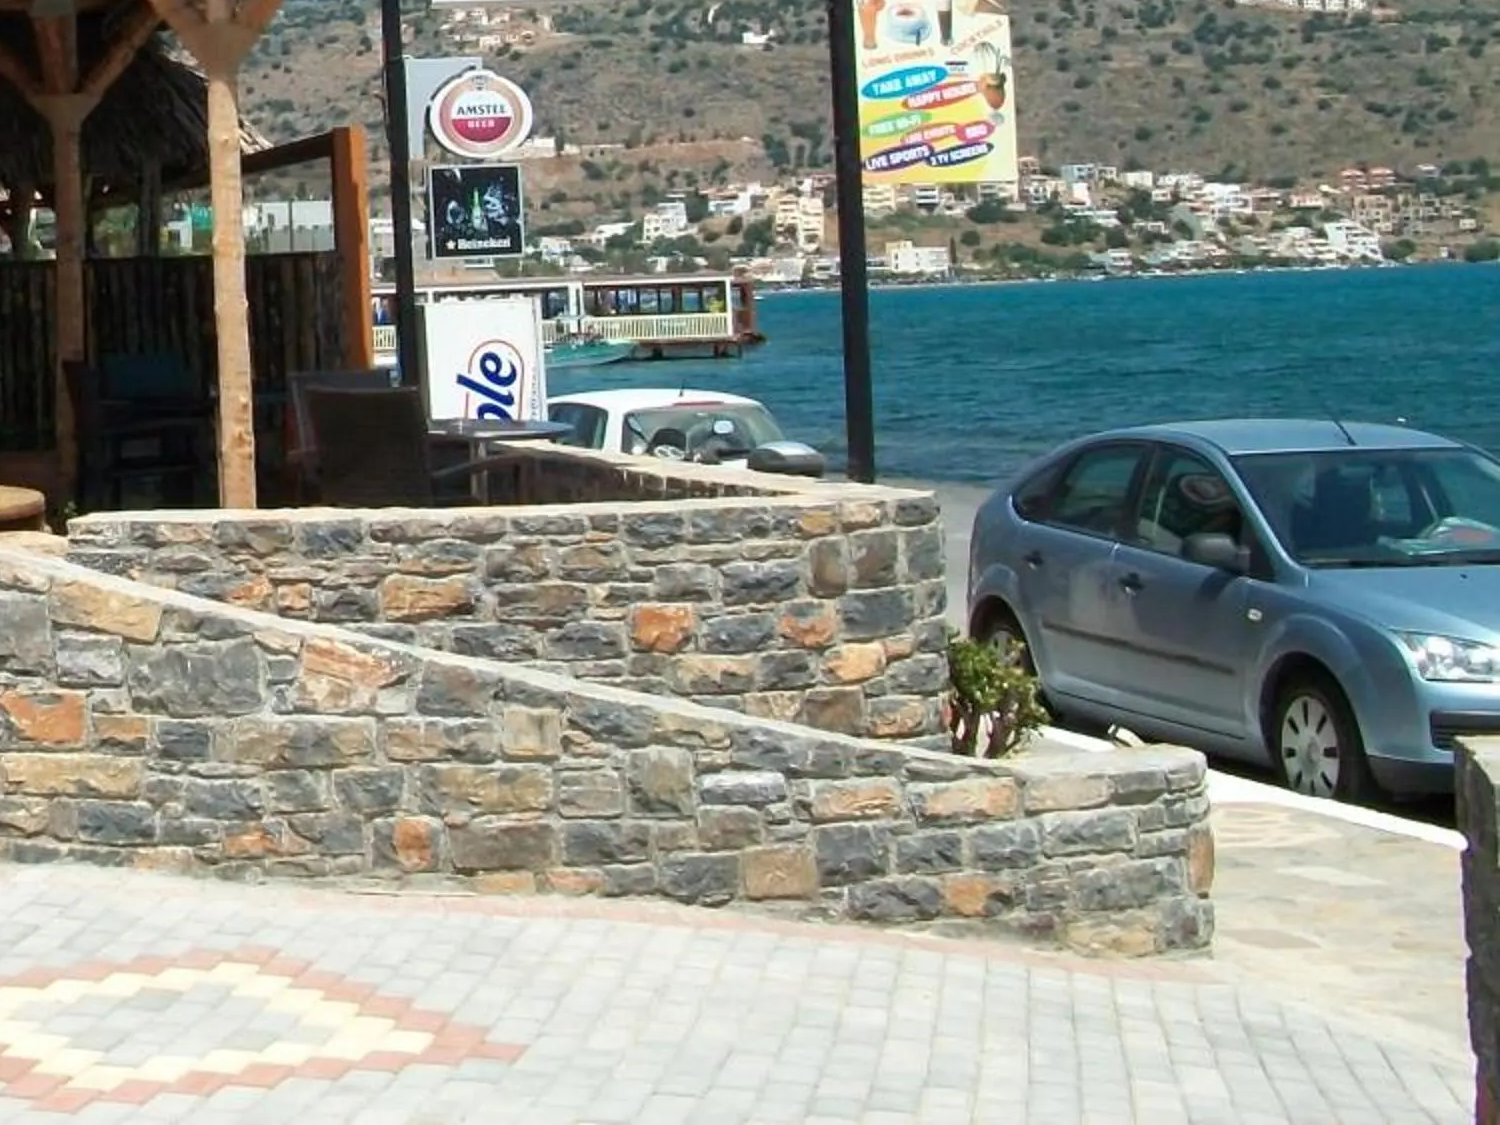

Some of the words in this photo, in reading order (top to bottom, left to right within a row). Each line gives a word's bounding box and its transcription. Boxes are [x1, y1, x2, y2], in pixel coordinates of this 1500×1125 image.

[872, 78, 902, 96] TAKE
[905, 70, 937, 88] AWAY
[908, 90, 941, 108] HAPPY
[457, 104, 507, 116] AMSTEL
[467, 119, 495, 128] BEER
[865, 155, 888, 171] LIVE
[890, 144, 931, 165] SPORTS
[938, 153, 950, 165] TV
[457, 236, 511, 250] Heineken
